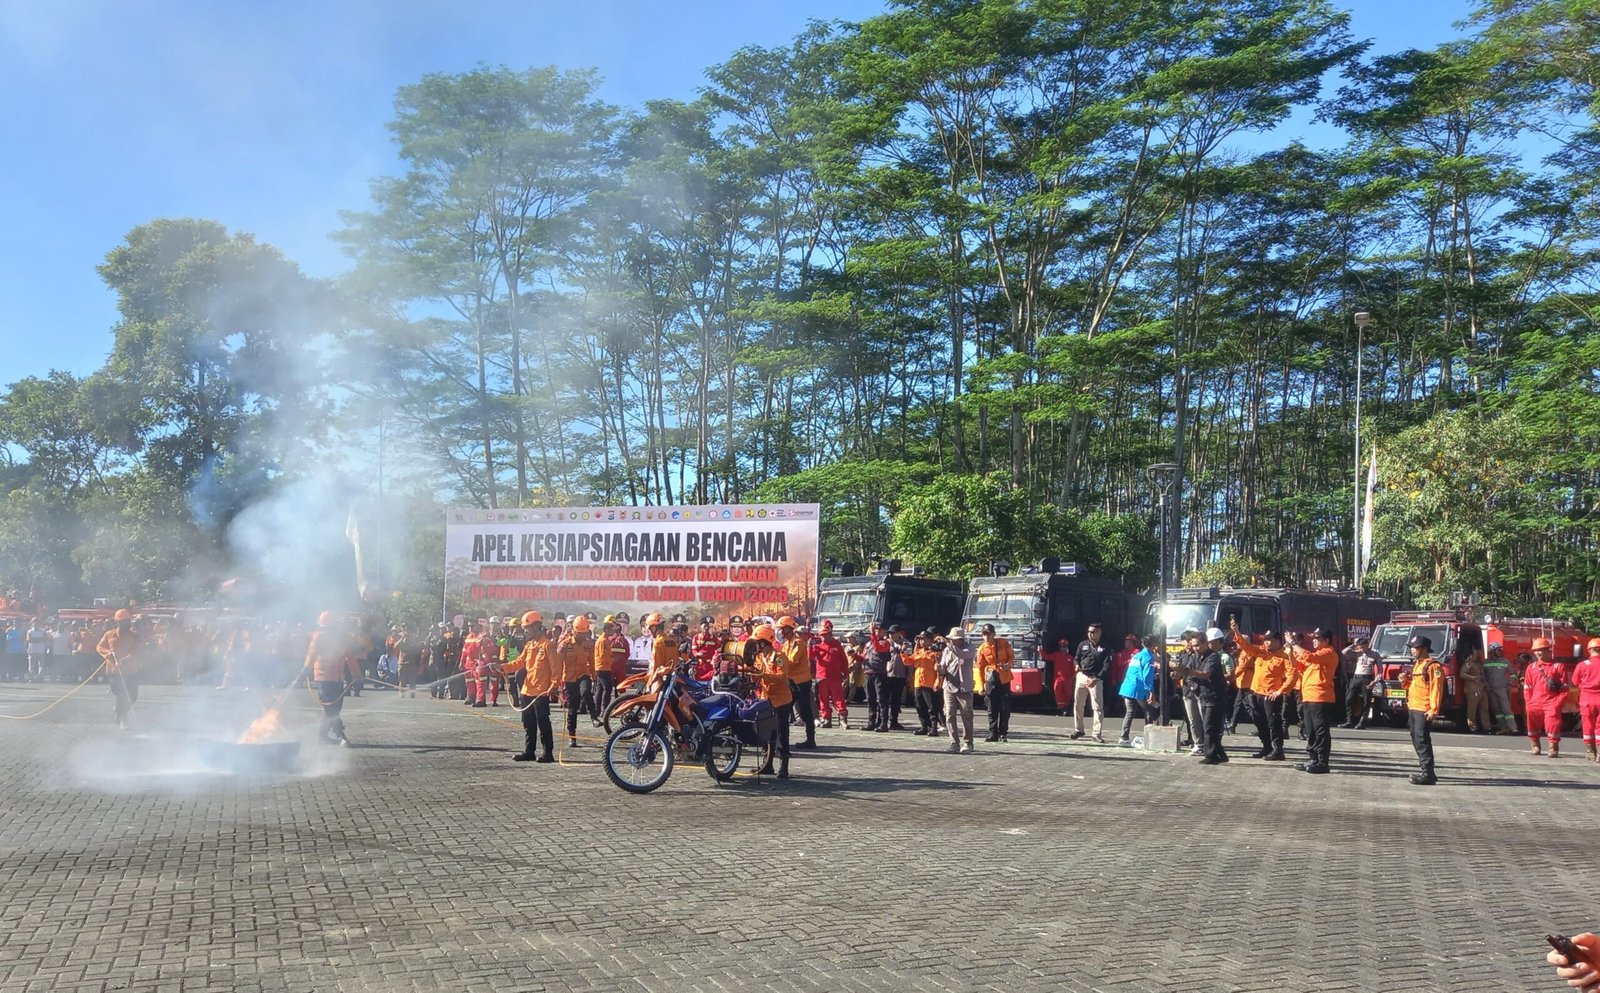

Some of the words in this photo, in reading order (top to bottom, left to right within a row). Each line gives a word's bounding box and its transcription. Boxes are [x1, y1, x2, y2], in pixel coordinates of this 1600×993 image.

[472, 534, 515, 561] APEL
[520, 532, 680, 562] KESIAPSIAGAAN
[686, 531, 787, 562] BENCANA
[480, 565, 563, 580] MENGHADAPI
[566, 565, 645, 581] KEBAKARAN
[649, 566, 695, 581] HUTAN
[698, 566, 727, 581] DAN
[730, 566, 778, 581] LAHAN
[487, 585, 547, 600] PROVINSI
[551, 586, 634, 601] KALIMANTAN
[637, 586, 695, 601] SELATAN
[698, 587, 745, 601] TAHUN
[750, 587, 788, 602] 2026
[1347, 625, 1371, 634] LAWAN
